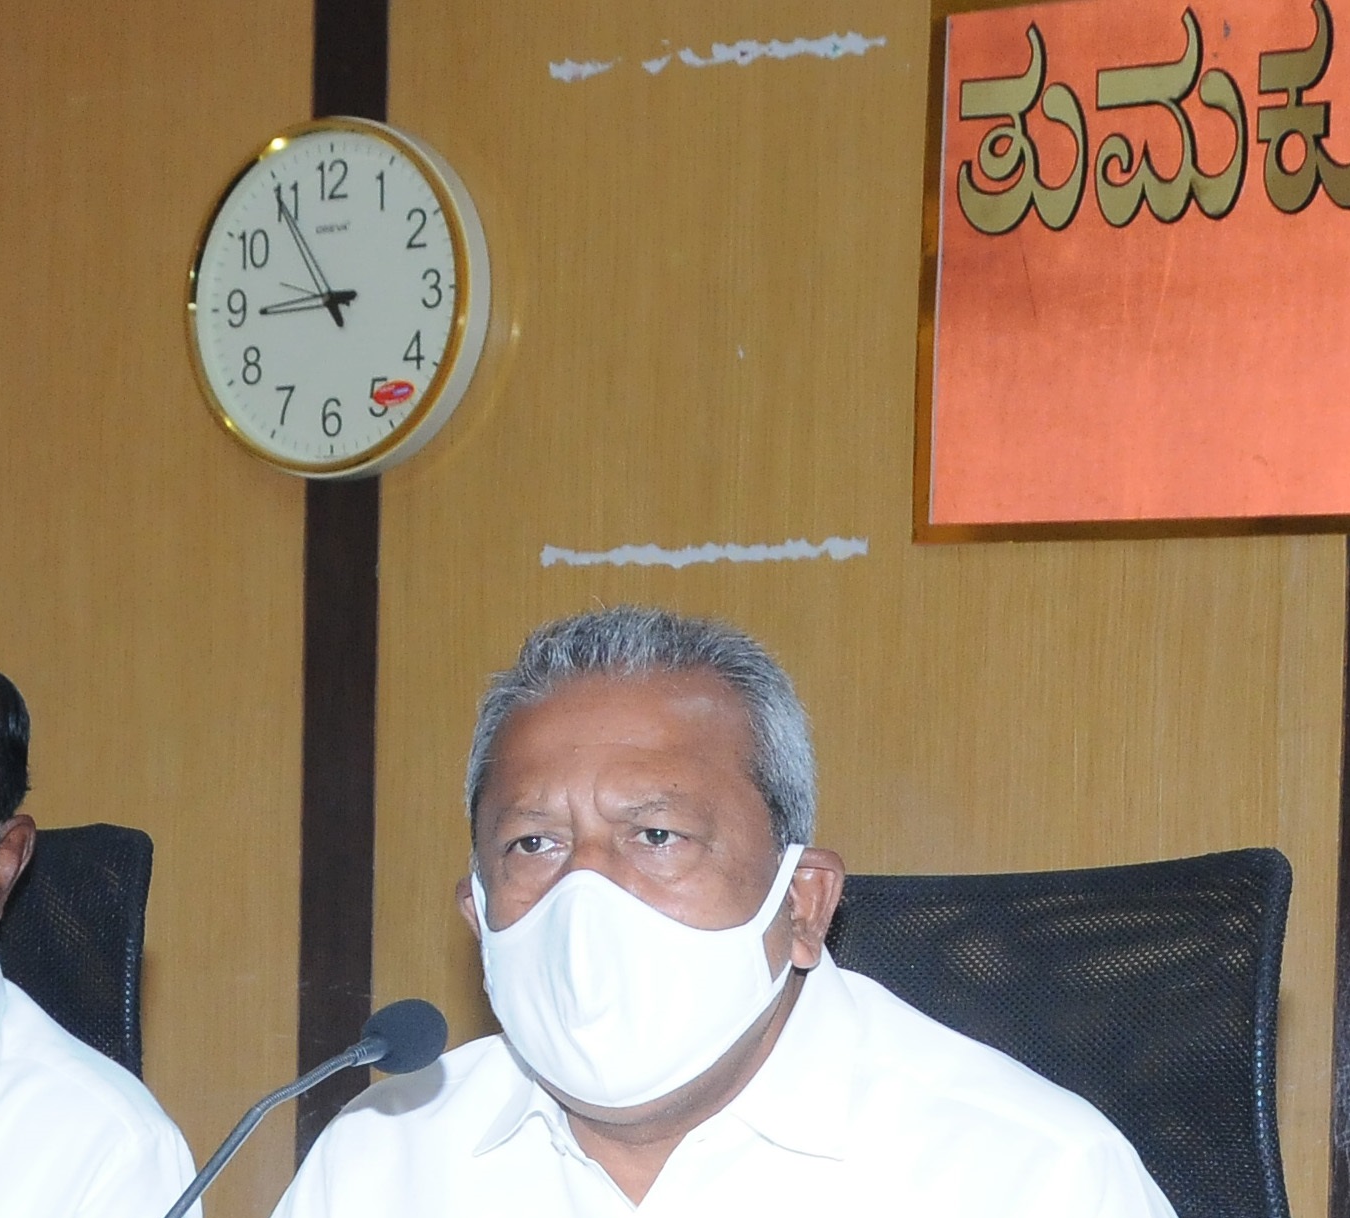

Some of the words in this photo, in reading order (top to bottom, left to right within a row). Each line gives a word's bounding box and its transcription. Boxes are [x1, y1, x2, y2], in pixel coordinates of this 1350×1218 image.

[274, 180, 299, 223] 11
[317, 159, 349, 202] 12
[375, 170, 386, 212] 1
[238, 228, 270, 270] 10
[406, 207, 428, 249] 2
[227, 288, 248, 329] 9
[421, 268, 443, 310] 3
[242, 345, 263, 386] 8
[402, 329, 426, 371] 4
[275, 385, 296, 426] 7
[321, 397, 343, 438] 6
